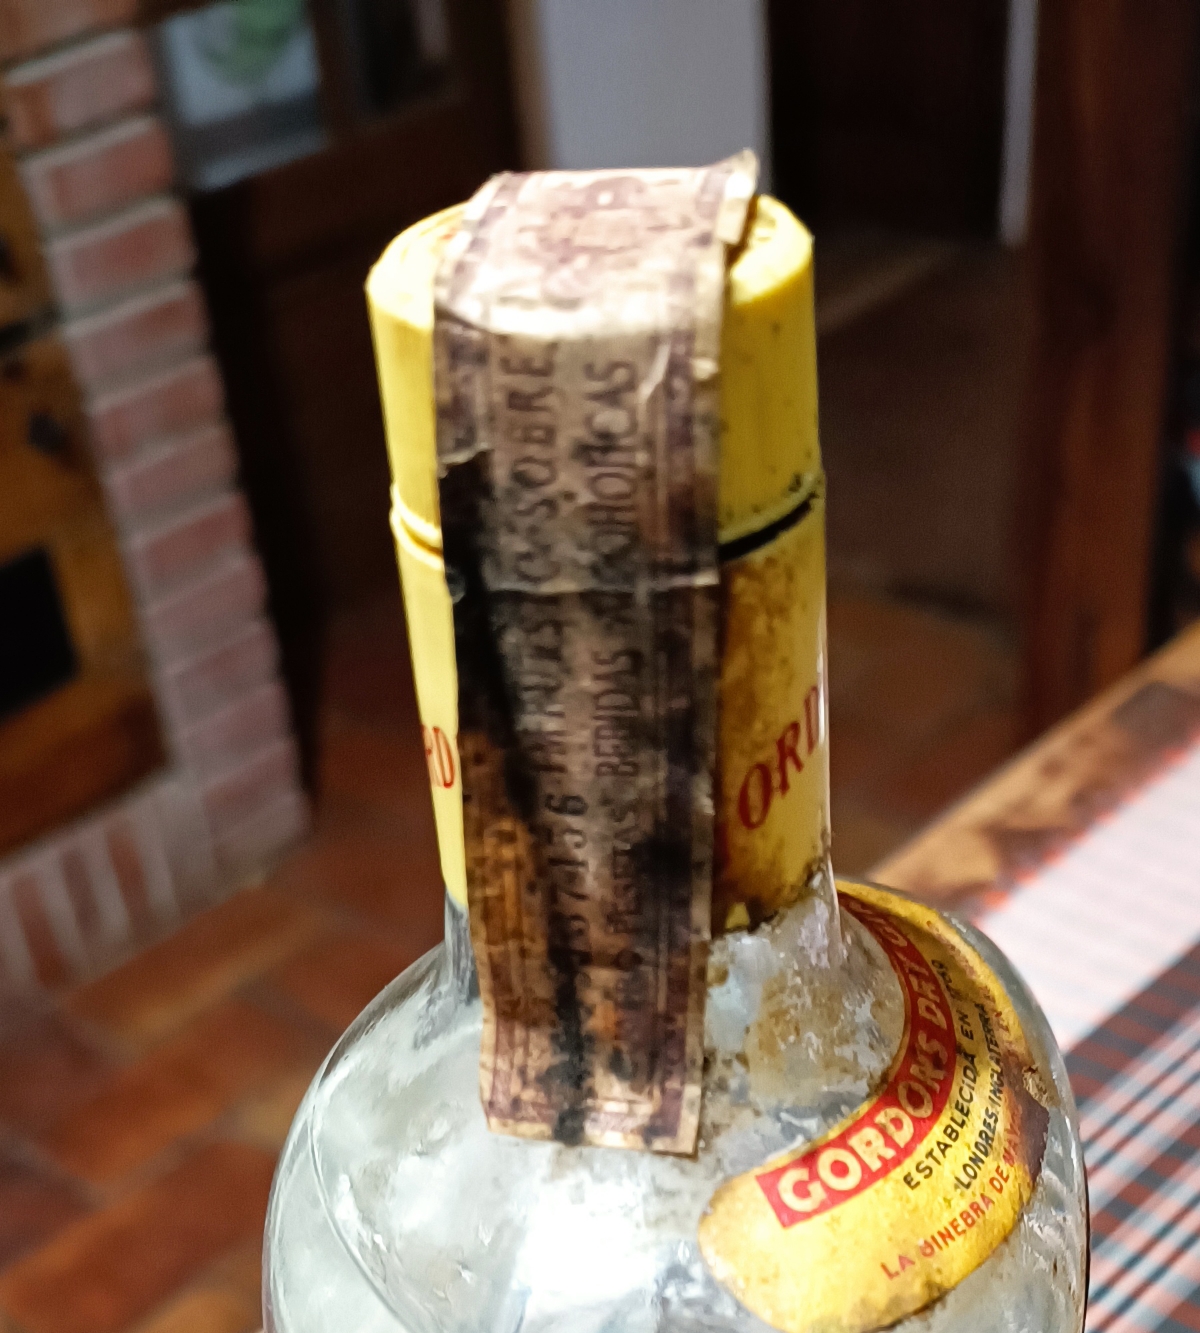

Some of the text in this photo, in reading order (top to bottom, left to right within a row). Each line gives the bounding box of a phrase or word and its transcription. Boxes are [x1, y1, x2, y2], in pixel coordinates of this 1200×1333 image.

[903, 1053, 977, 1190] ESTABLECIDA
[955, 1008, 975, 1042] EN
[880, 1255, 915, 1280] LA
[919, 1193, 995, 1258] GINEBRA
[989, 1165, 1010, 1195] DE
